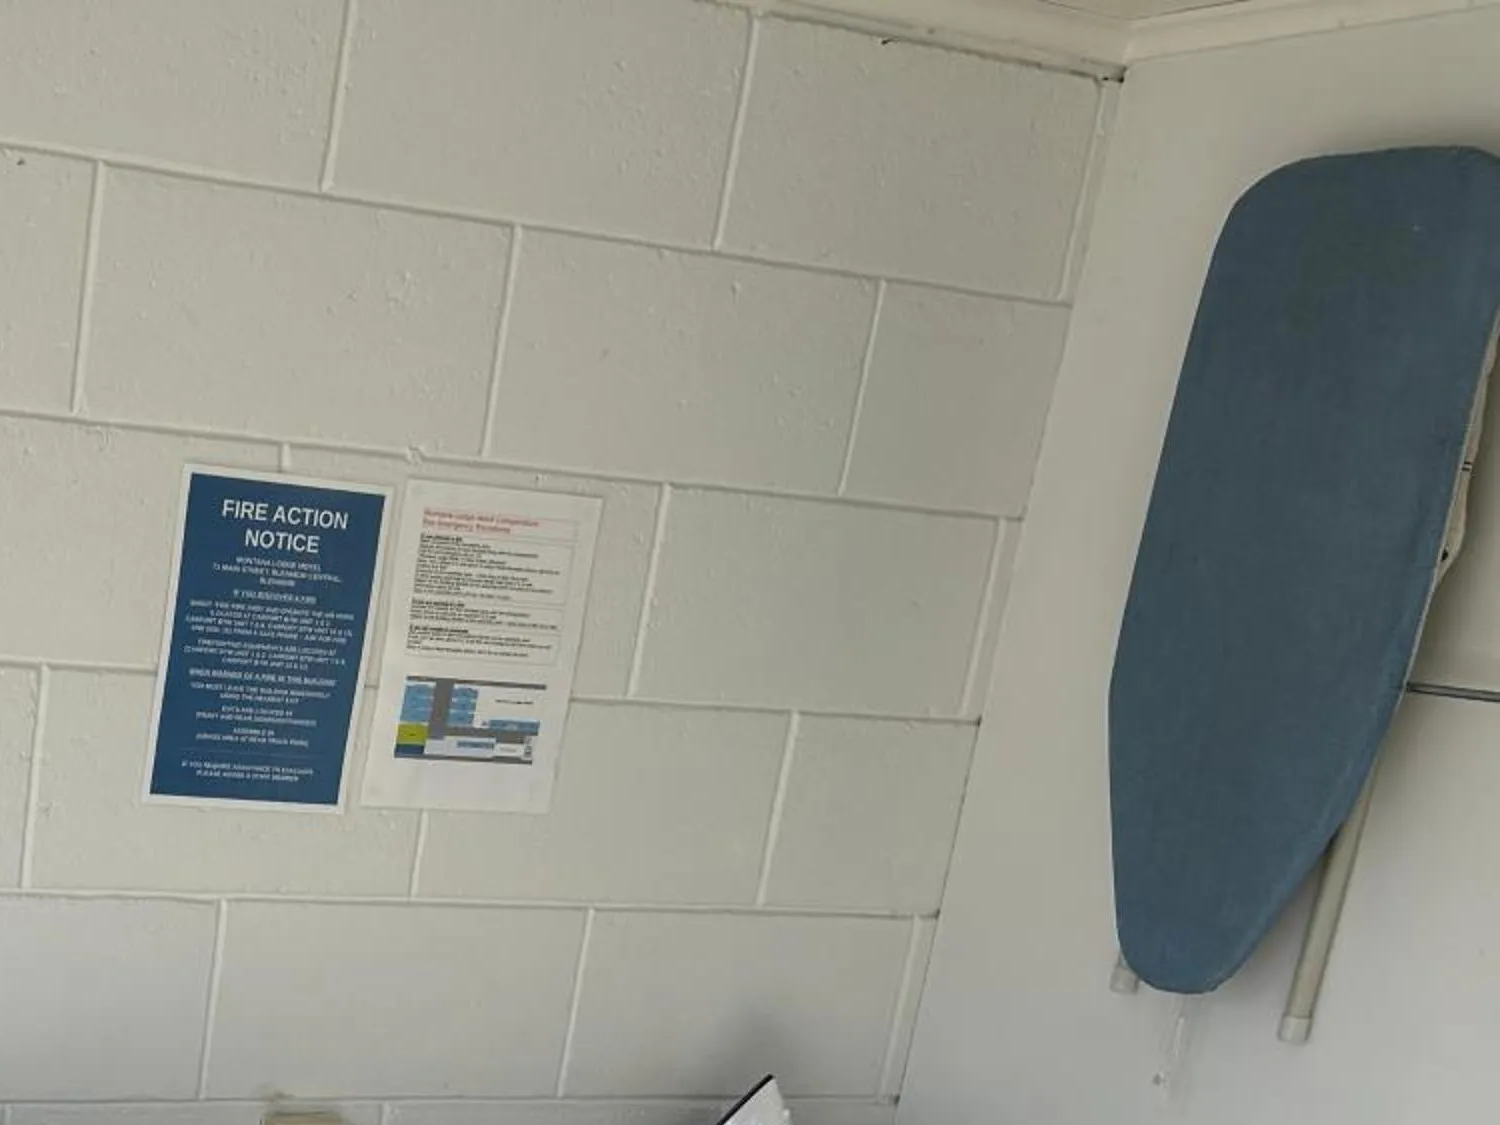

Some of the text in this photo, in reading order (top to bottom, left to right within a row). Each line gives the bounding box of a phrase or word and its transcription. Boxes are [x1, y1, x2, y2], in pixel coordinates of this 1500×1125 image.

[221, 499, 349, 530] FIRE ACTION
[244, 528, 321, 554] NOTICE
